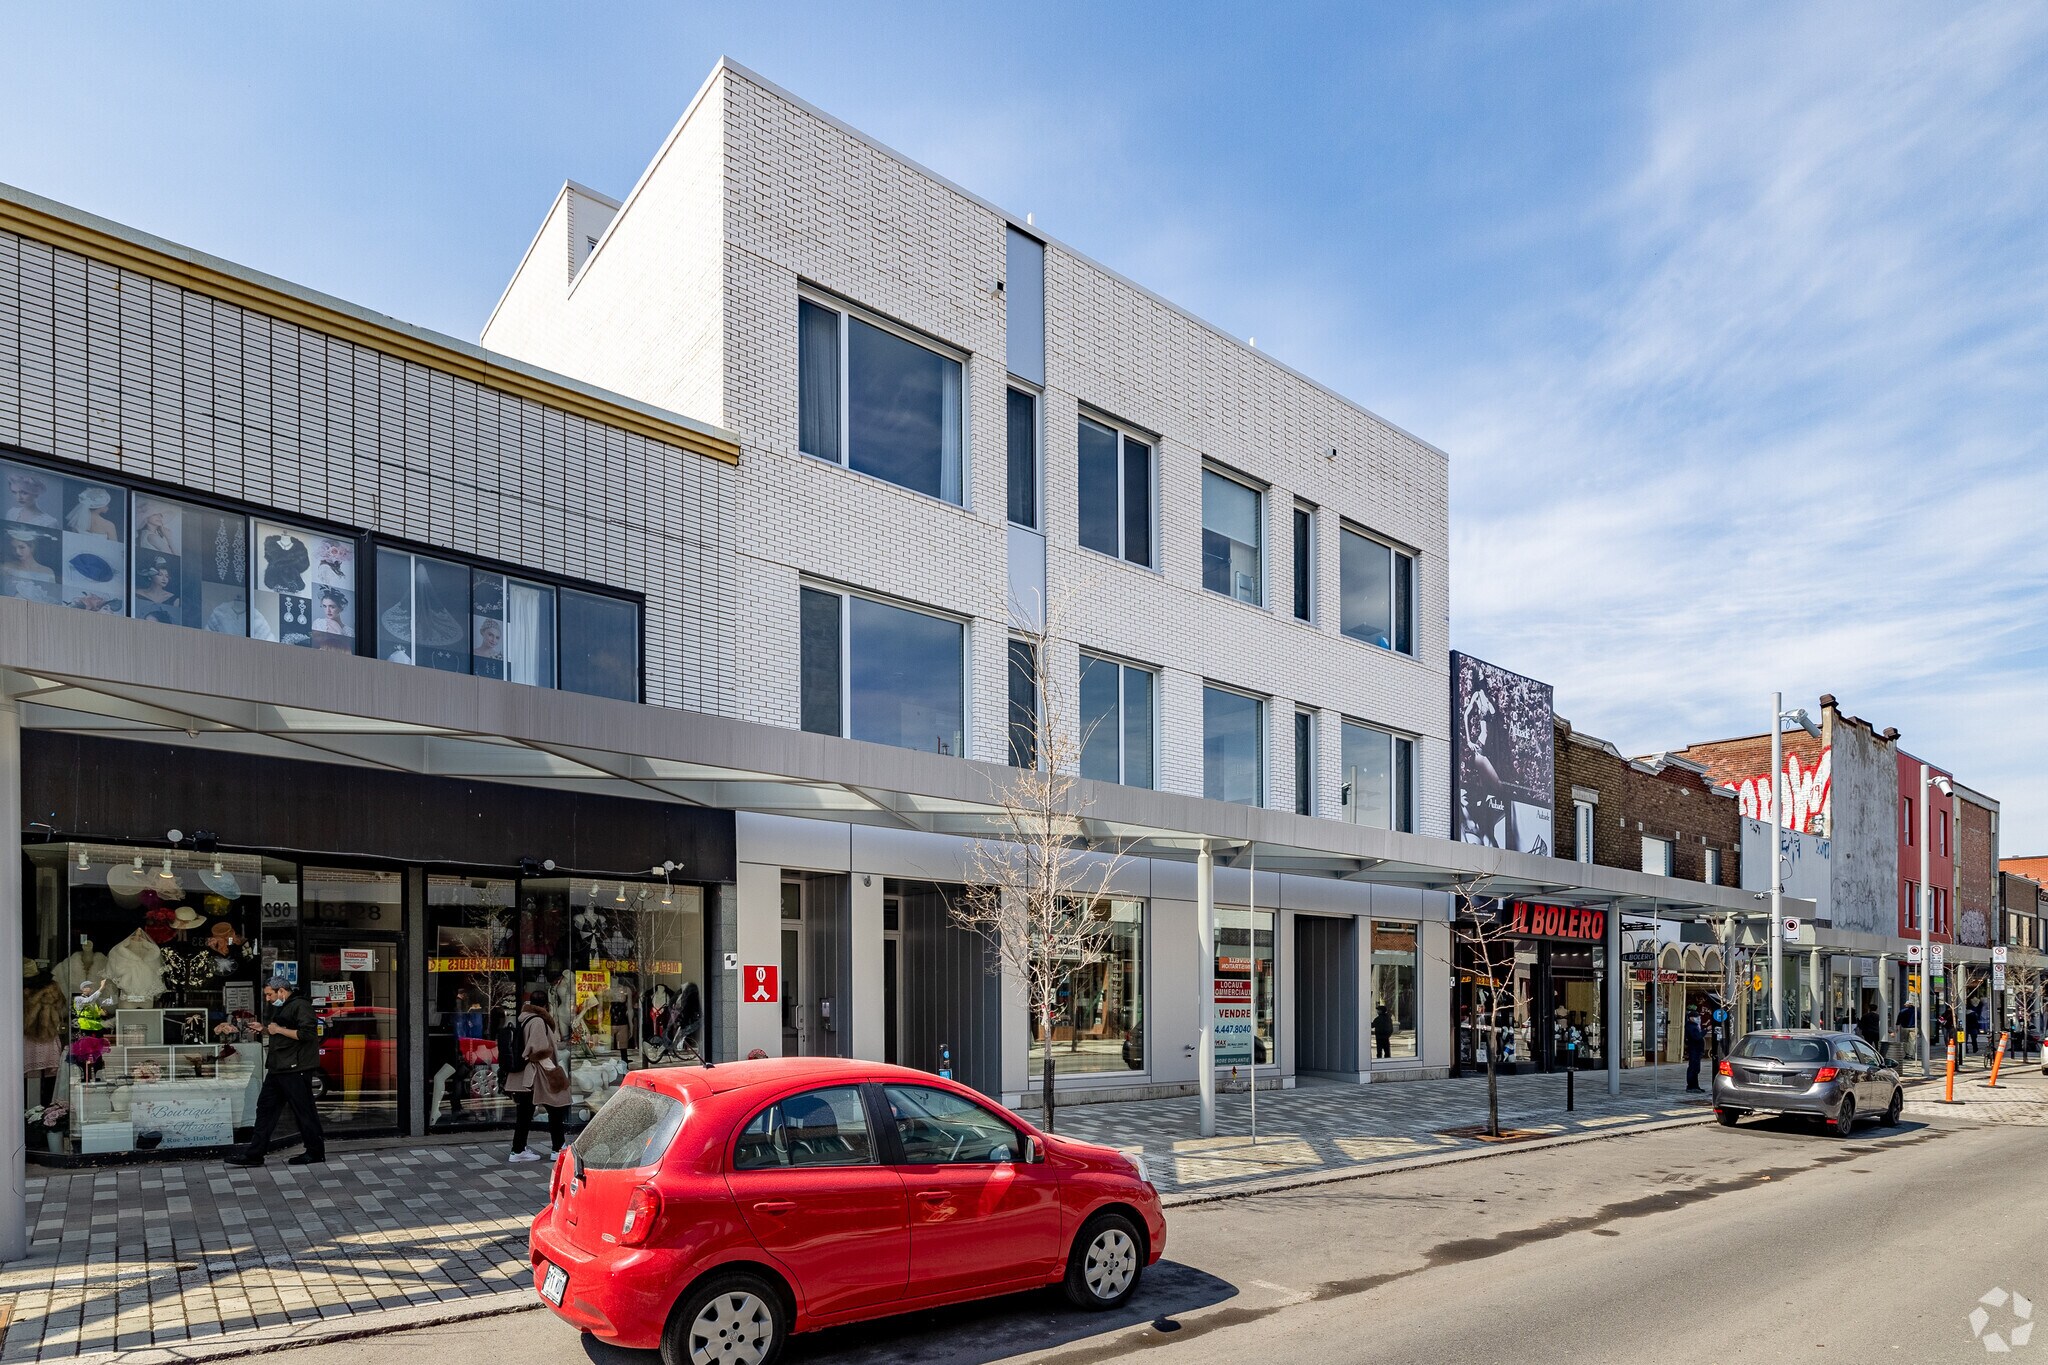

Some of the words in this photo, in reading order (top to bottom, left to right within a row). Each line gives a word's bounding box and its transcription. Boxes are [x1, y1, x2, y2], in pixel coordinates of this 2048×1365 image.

[1511, 901, 1529, 934] IL
[1531, 904, 1604, 940] BOLERO
[1629, 953, 1655, 961] BOLERO
[1220, 981, 1243, 989] LOCAUX
[1215, 988, 1251, 996] OMMERCIAUX
[1219, 1009, 1251, 1018] VENDRE
[1214, 1024, 1251, 1034] 4.447.8040
[151, 1105, 216, 1119] Boutique
[183, 1135, 217, 1143] St-Hubert
